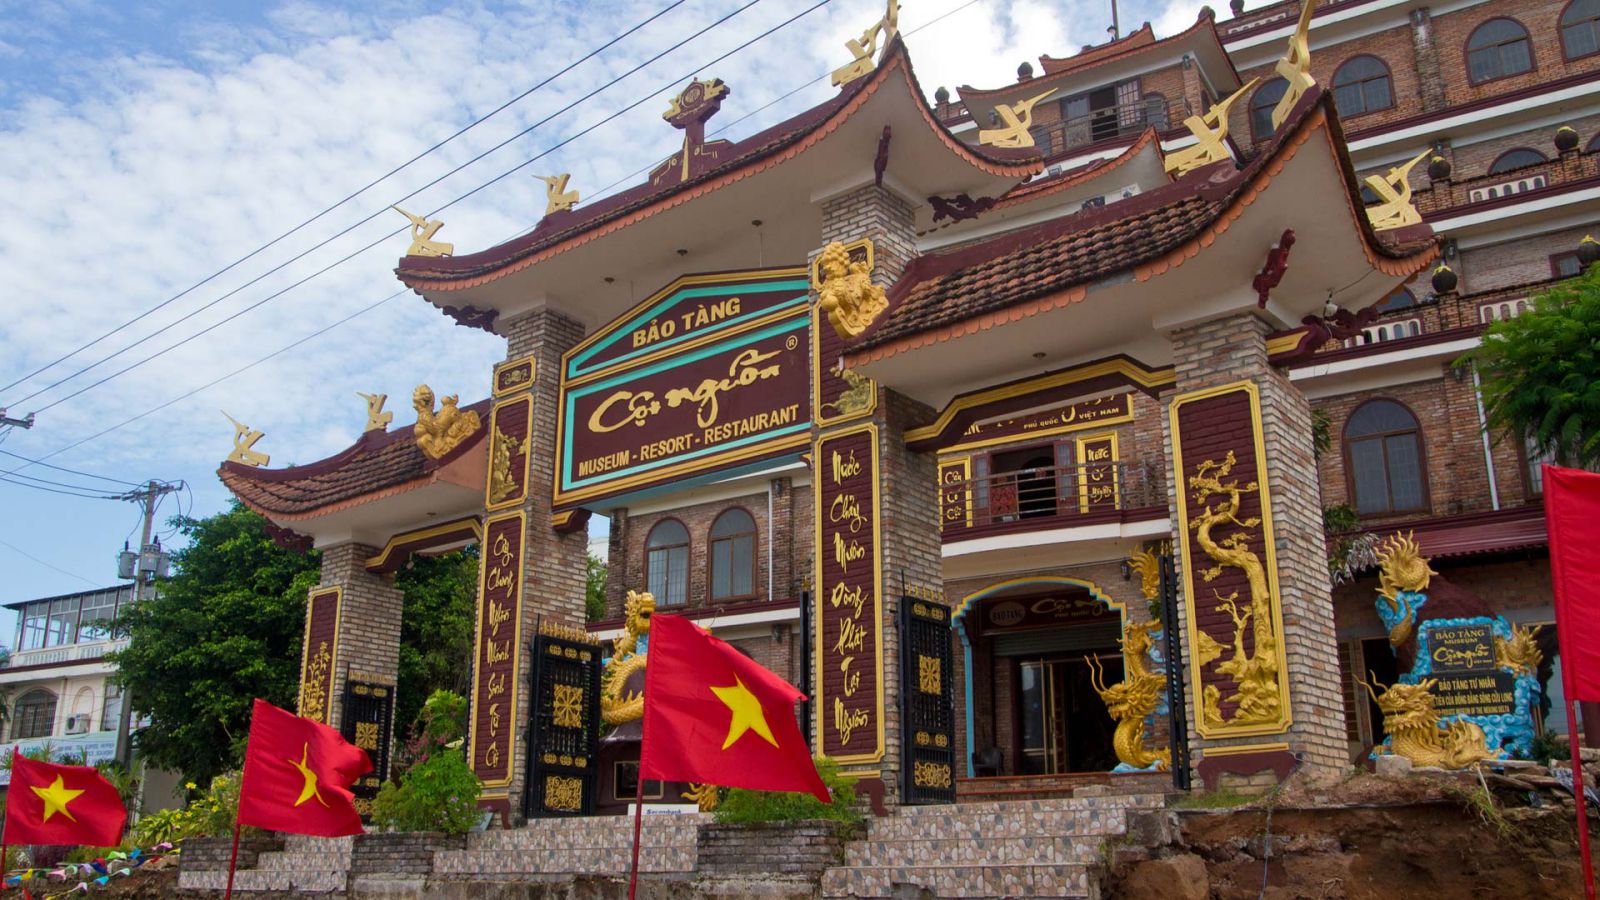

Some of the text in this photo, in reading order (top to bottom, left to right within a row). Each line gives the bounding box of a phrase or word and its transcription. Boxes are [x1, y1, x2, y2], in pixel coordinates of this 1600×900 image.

[633, 298, 741, 349] BẢO TÀNG
[1078, 411, 1097, 421] VIỆT
[1100, 407, 1119, 416] NAM
[578, 449, 630, 477] MUSEUM
[640, 433, 694, 462] RESORT
[704, 403, 799, 445] RESTAURANT
[830, 449, 869, 746] Nước Chảy Muôn Dòng Phát Tại Nguồn
[1435, 628, 1485, 640] BẢO TÀNG
[1439, 678, 1452, 691] BẢO
[1452, 678, 1469, 690] TÀNG
[1479, 676, 1496, 688] NHÂN
